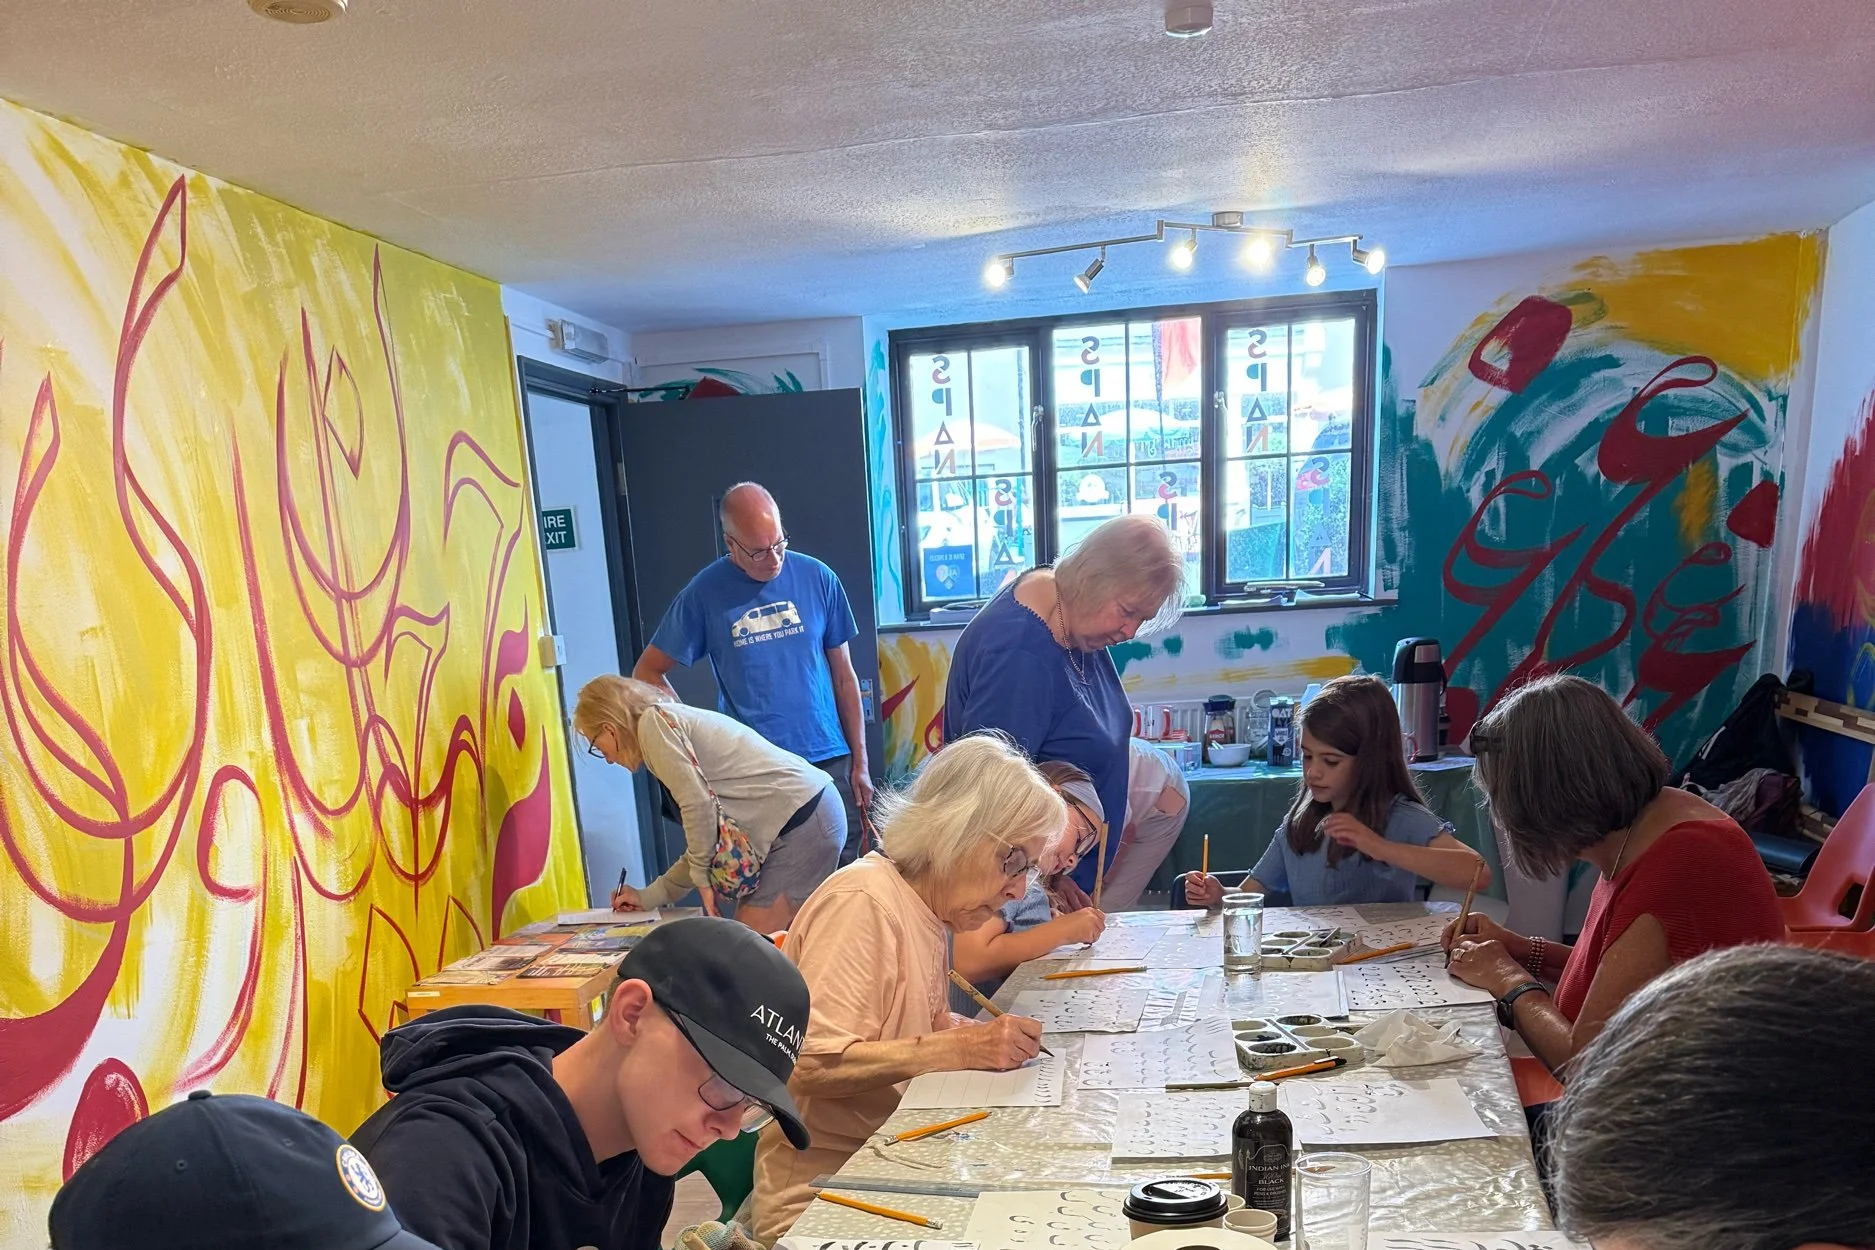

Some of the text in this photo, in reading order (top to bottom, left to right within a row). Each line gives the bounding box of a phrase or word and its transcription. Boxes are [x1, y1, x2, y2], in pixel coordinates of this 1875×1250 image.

[543, 514, 567, 529] IRE
[545, 531, 567, 545] XIT
[748, 636, 755, 644] IS
[755, 633, 773, 643] WHERE
[773, 630, 784, 639] YOU
[784, 627, 799, 637] PARK
[799, 625, 805, 633] IT
[765, 1032, 778, 1046] THE
